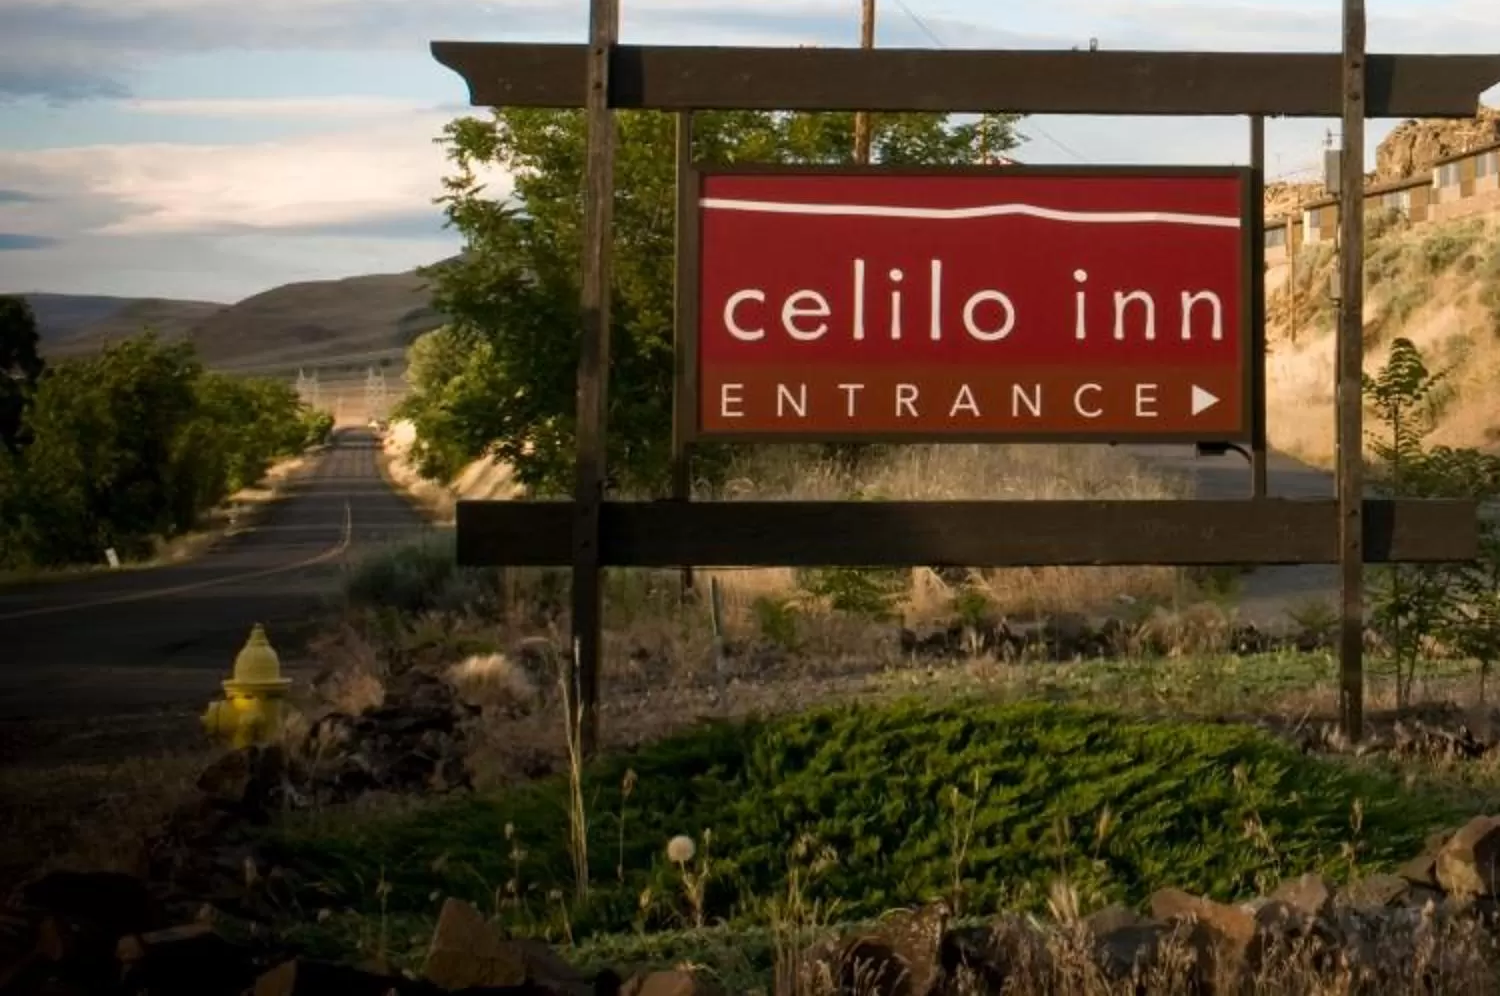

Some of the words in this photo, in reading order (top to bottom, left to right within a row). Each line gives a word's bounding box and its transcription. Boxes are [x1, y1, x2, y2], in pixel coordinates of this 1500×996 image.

[723, 258, 1015, 341] celilo
[1072, 268, 1224, 340] inn
[720, 382, 1159, 418] ENTRANCE
